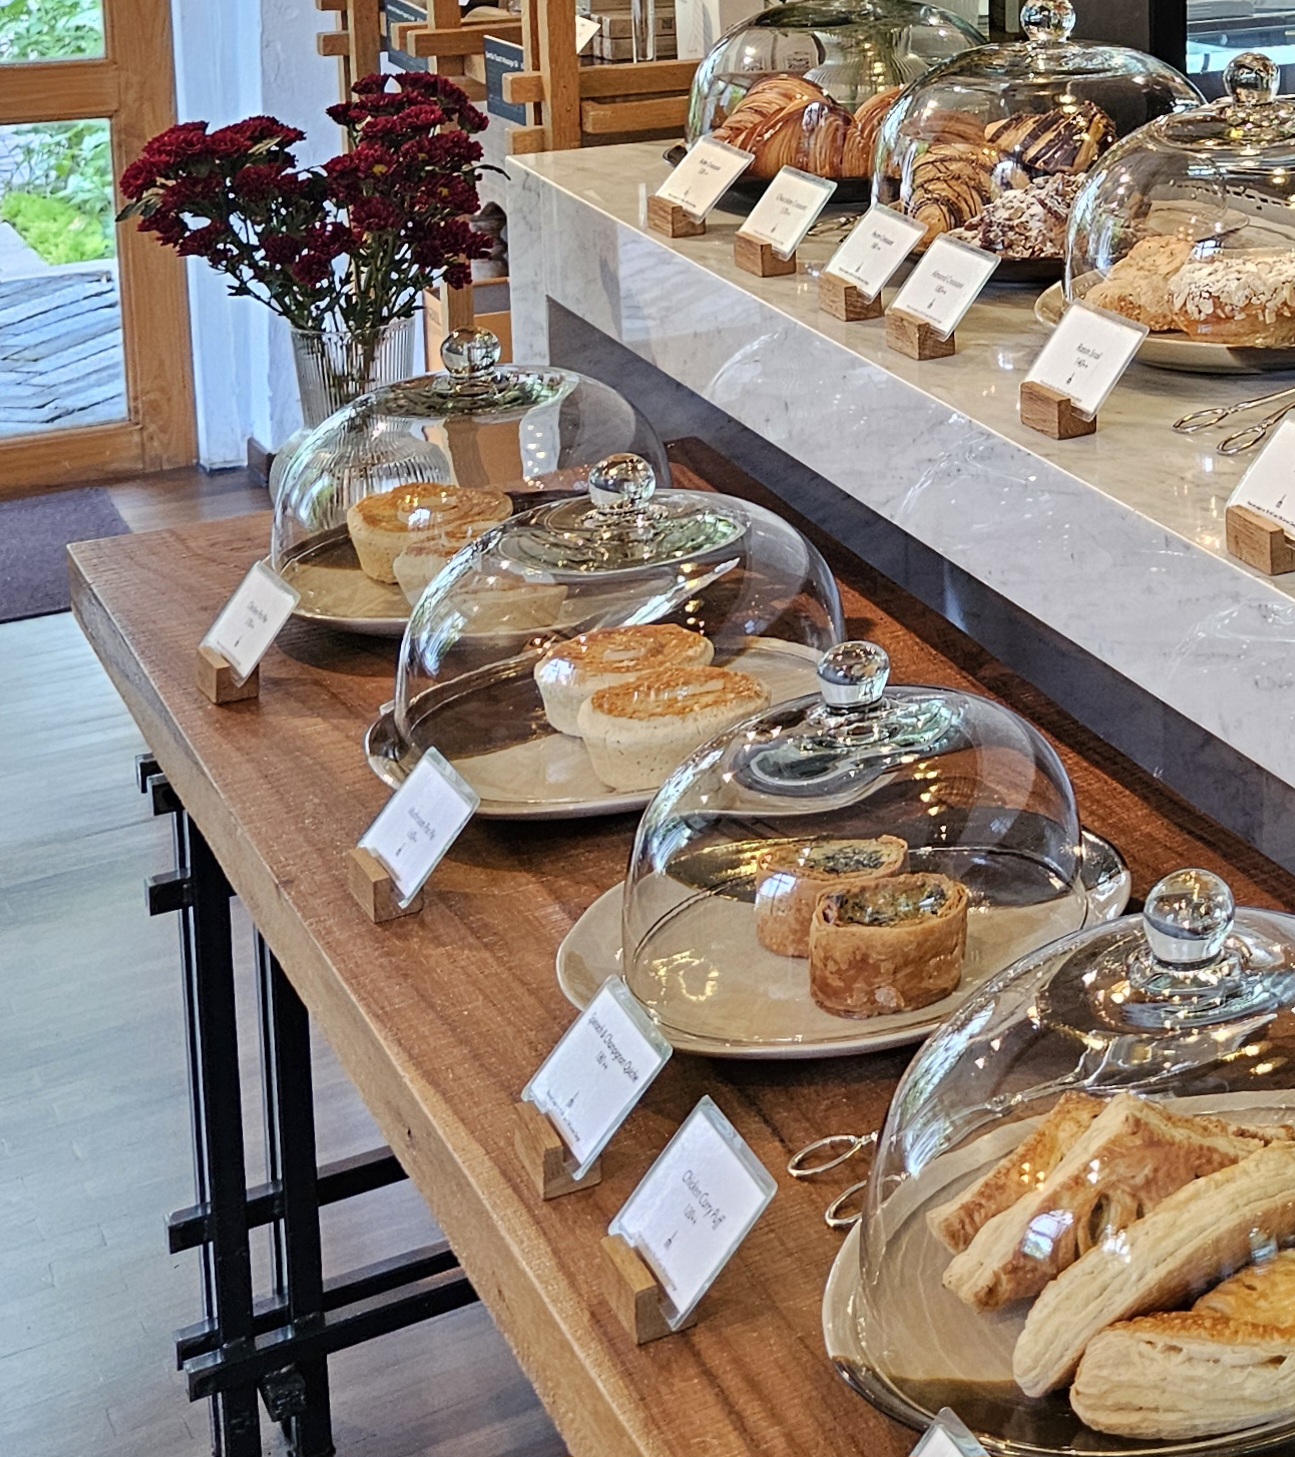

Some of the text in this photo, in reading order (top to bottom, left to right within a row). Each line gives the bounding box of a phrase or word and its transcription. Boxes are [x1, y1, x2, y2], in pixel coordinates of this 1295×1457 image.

[601, 1033, 628, 1067] Champignon
[621, 1059, 641, 1084] Quiche
[681, 1169, 725, 1230] Chicken Curry Puff
